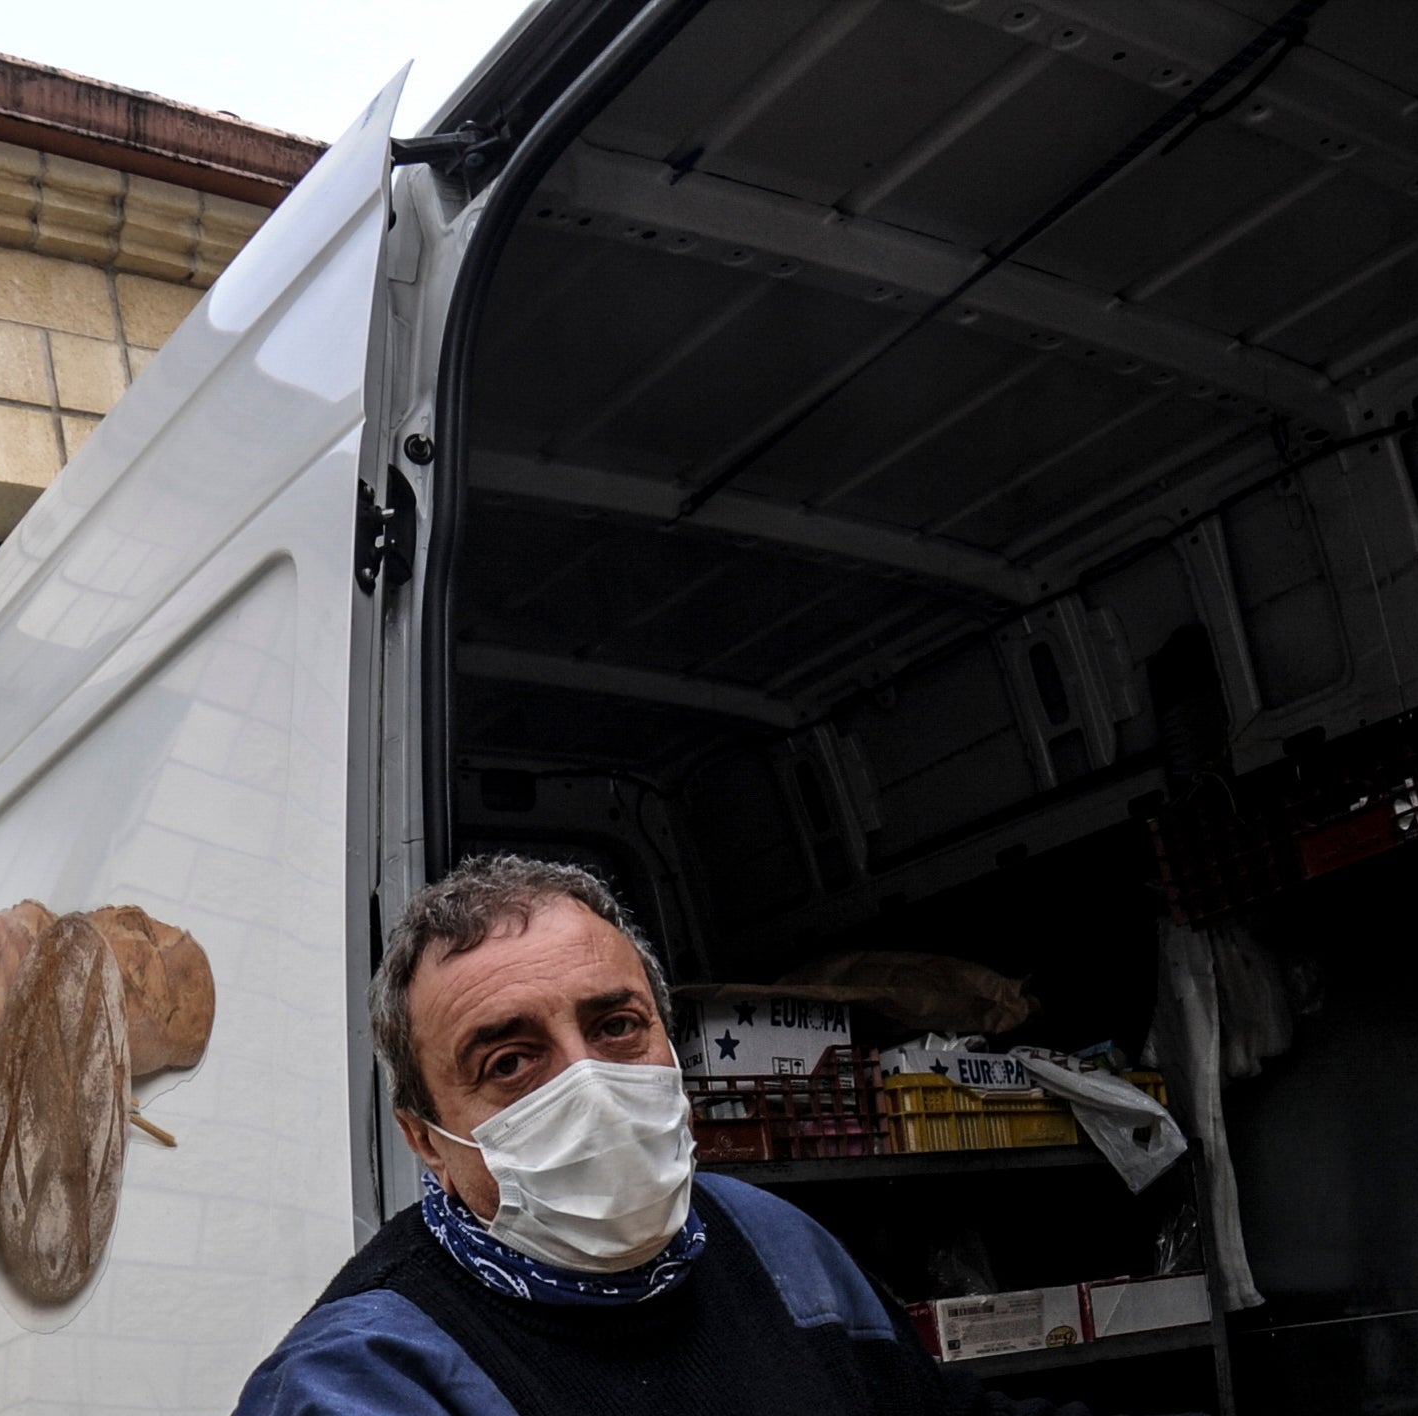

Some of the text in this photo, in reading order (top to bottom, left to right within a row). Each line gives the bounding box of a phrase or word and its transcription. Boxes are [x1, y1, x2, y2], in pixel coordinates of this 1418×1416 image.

[771, 999, 847, 1033] EUROPA
[680, 1052, 703, 1070] AURI
[958, 1058, 1026, 1085] EUROPA
